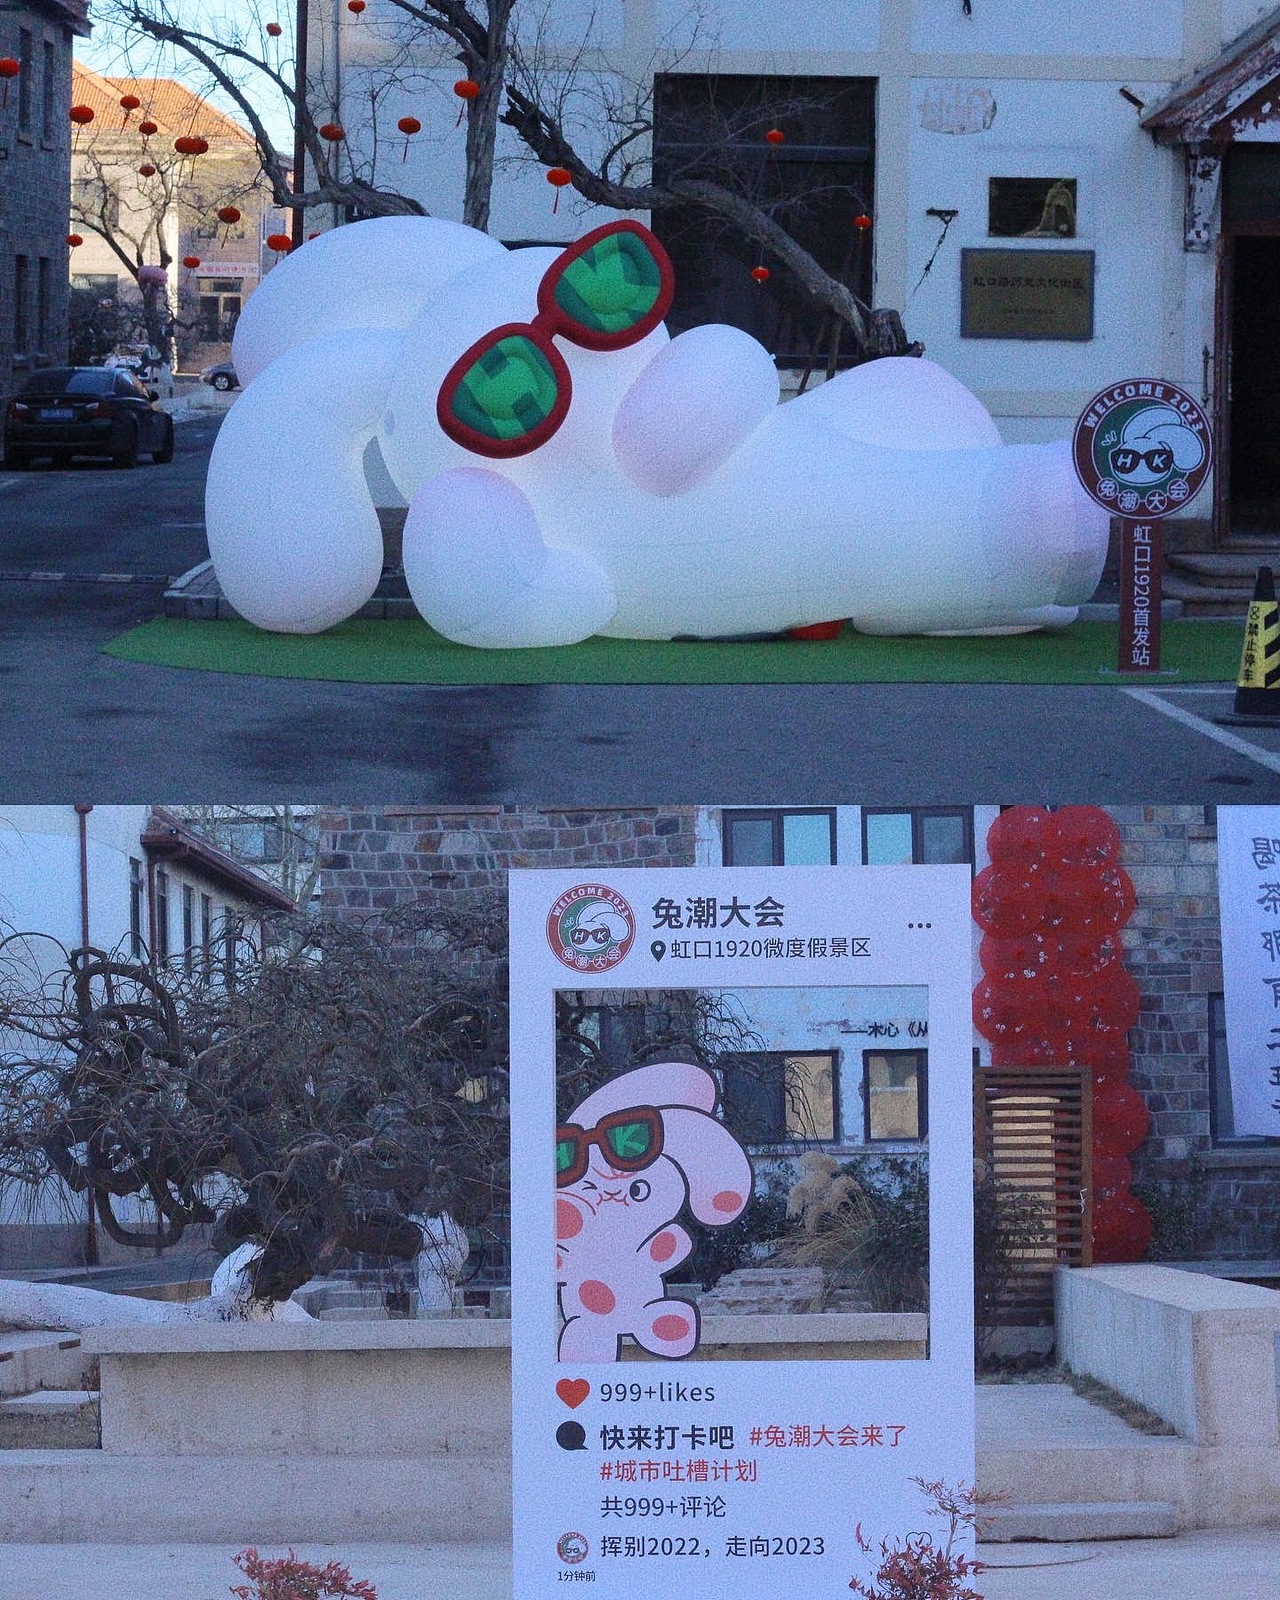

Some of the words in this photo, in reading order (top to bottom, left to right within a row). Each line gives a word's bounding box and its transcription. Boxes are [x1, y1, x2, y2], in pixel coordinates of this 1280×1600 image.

[1084, 384, 1164, 428] WELCOME
[1170, 394, 1204, 432] 2023
[1100, 480, 1188, 512] 兔潮大会
[1131, 525, 1152, 665] 虹口1920首发站
[553, 887, 604, 917] WELCOME
[606, 892, 630, 917] 2023
[651, 896, 785, 930] 兔潮大会
[670, 937, 872, 960] 虹口1920微度假景区
[600, 1382, 716, 1402] 999+likes
[600, 1425, 735, 1451] 快来打卡吧
[749, 1424, 908, 1448] #兔潮大会来了
[600, 1459, 758, 1483] #城市吐槽计划
[600, 1495, 727, 1519] 共999+评论
[600, 1535, 825, 1558] 挥别2022，走向2023
[557, 1570, 596, 1582] 1分钟前
